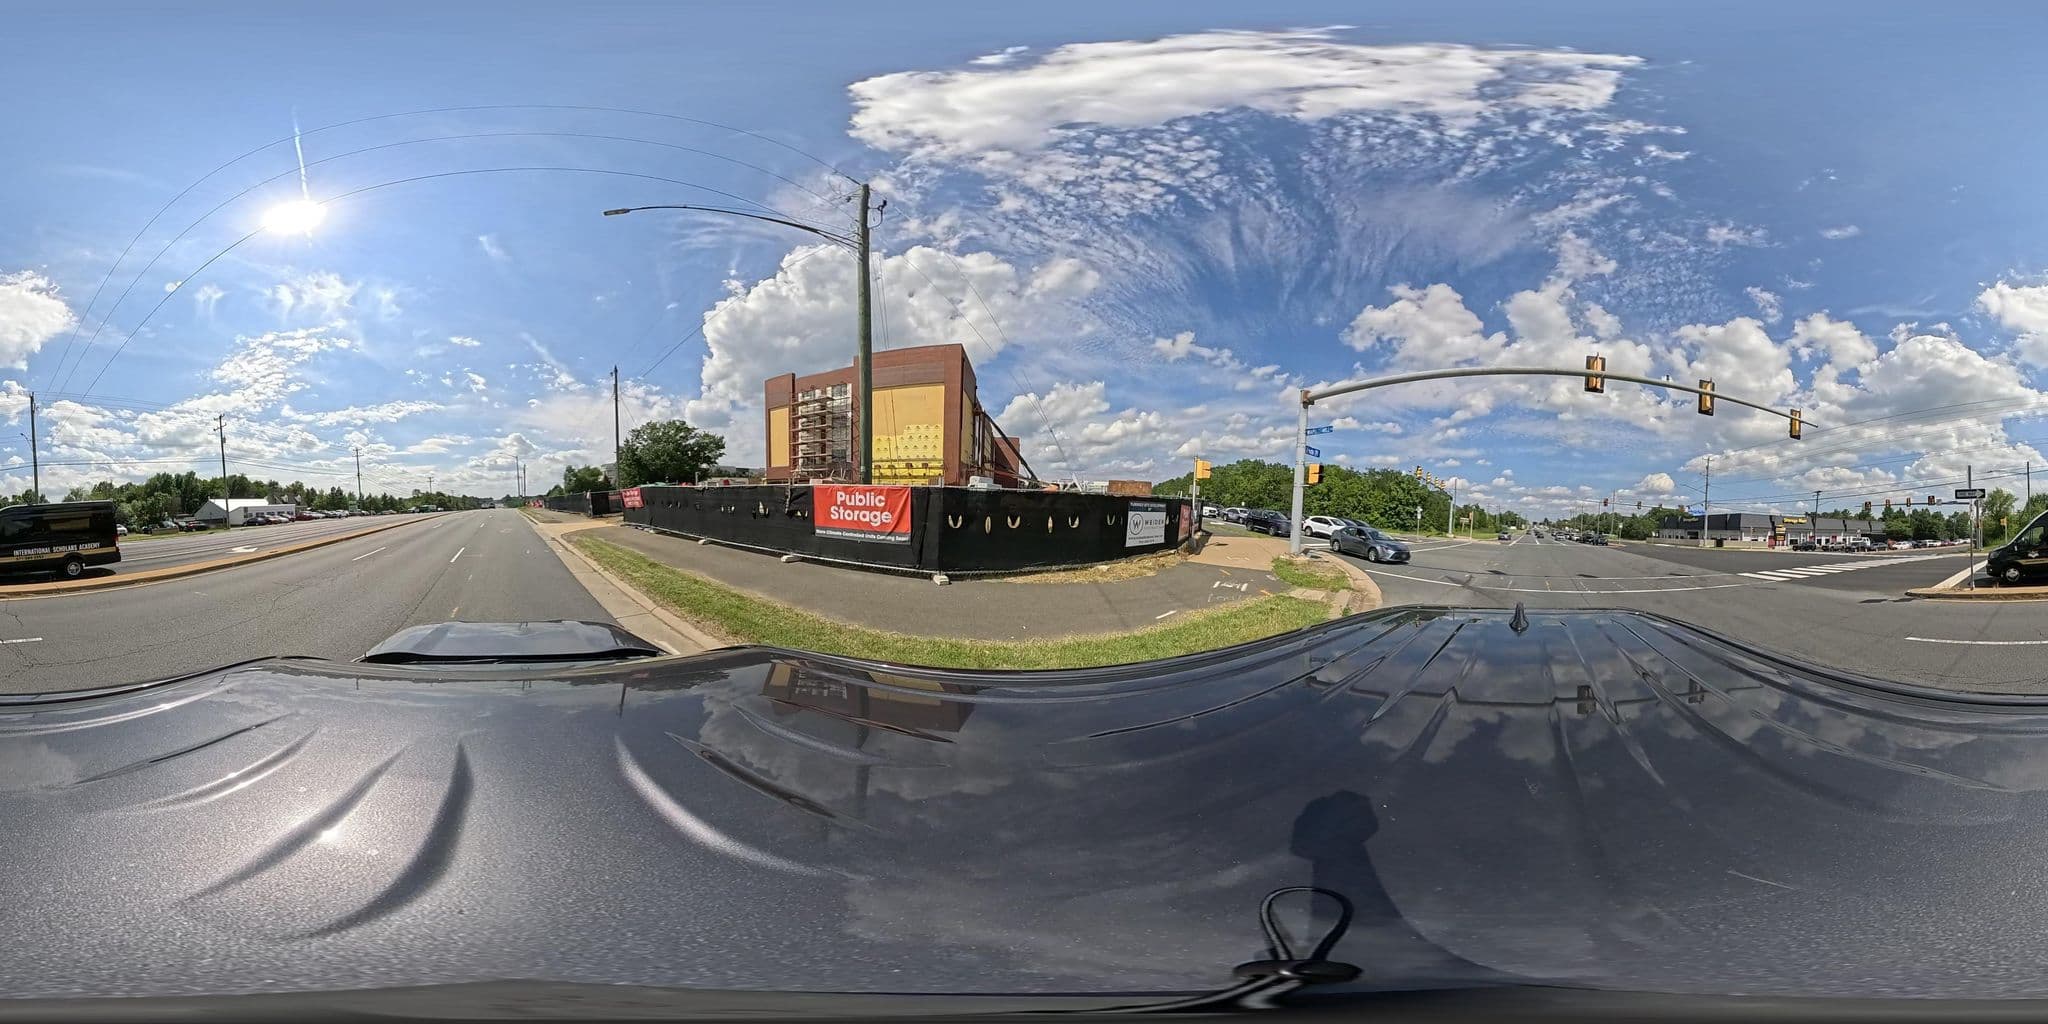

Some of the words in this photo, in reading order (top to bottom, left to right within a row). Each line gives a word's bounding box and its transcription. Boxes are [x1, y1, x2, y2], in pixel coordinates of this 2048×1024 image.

[837, 491, 885, 507] Public
[830, 506, 892, 526] Storage
[13, 547, 50, 556] INTERNATIONAL
[53, 544, 77, 553] SCHOLARS
